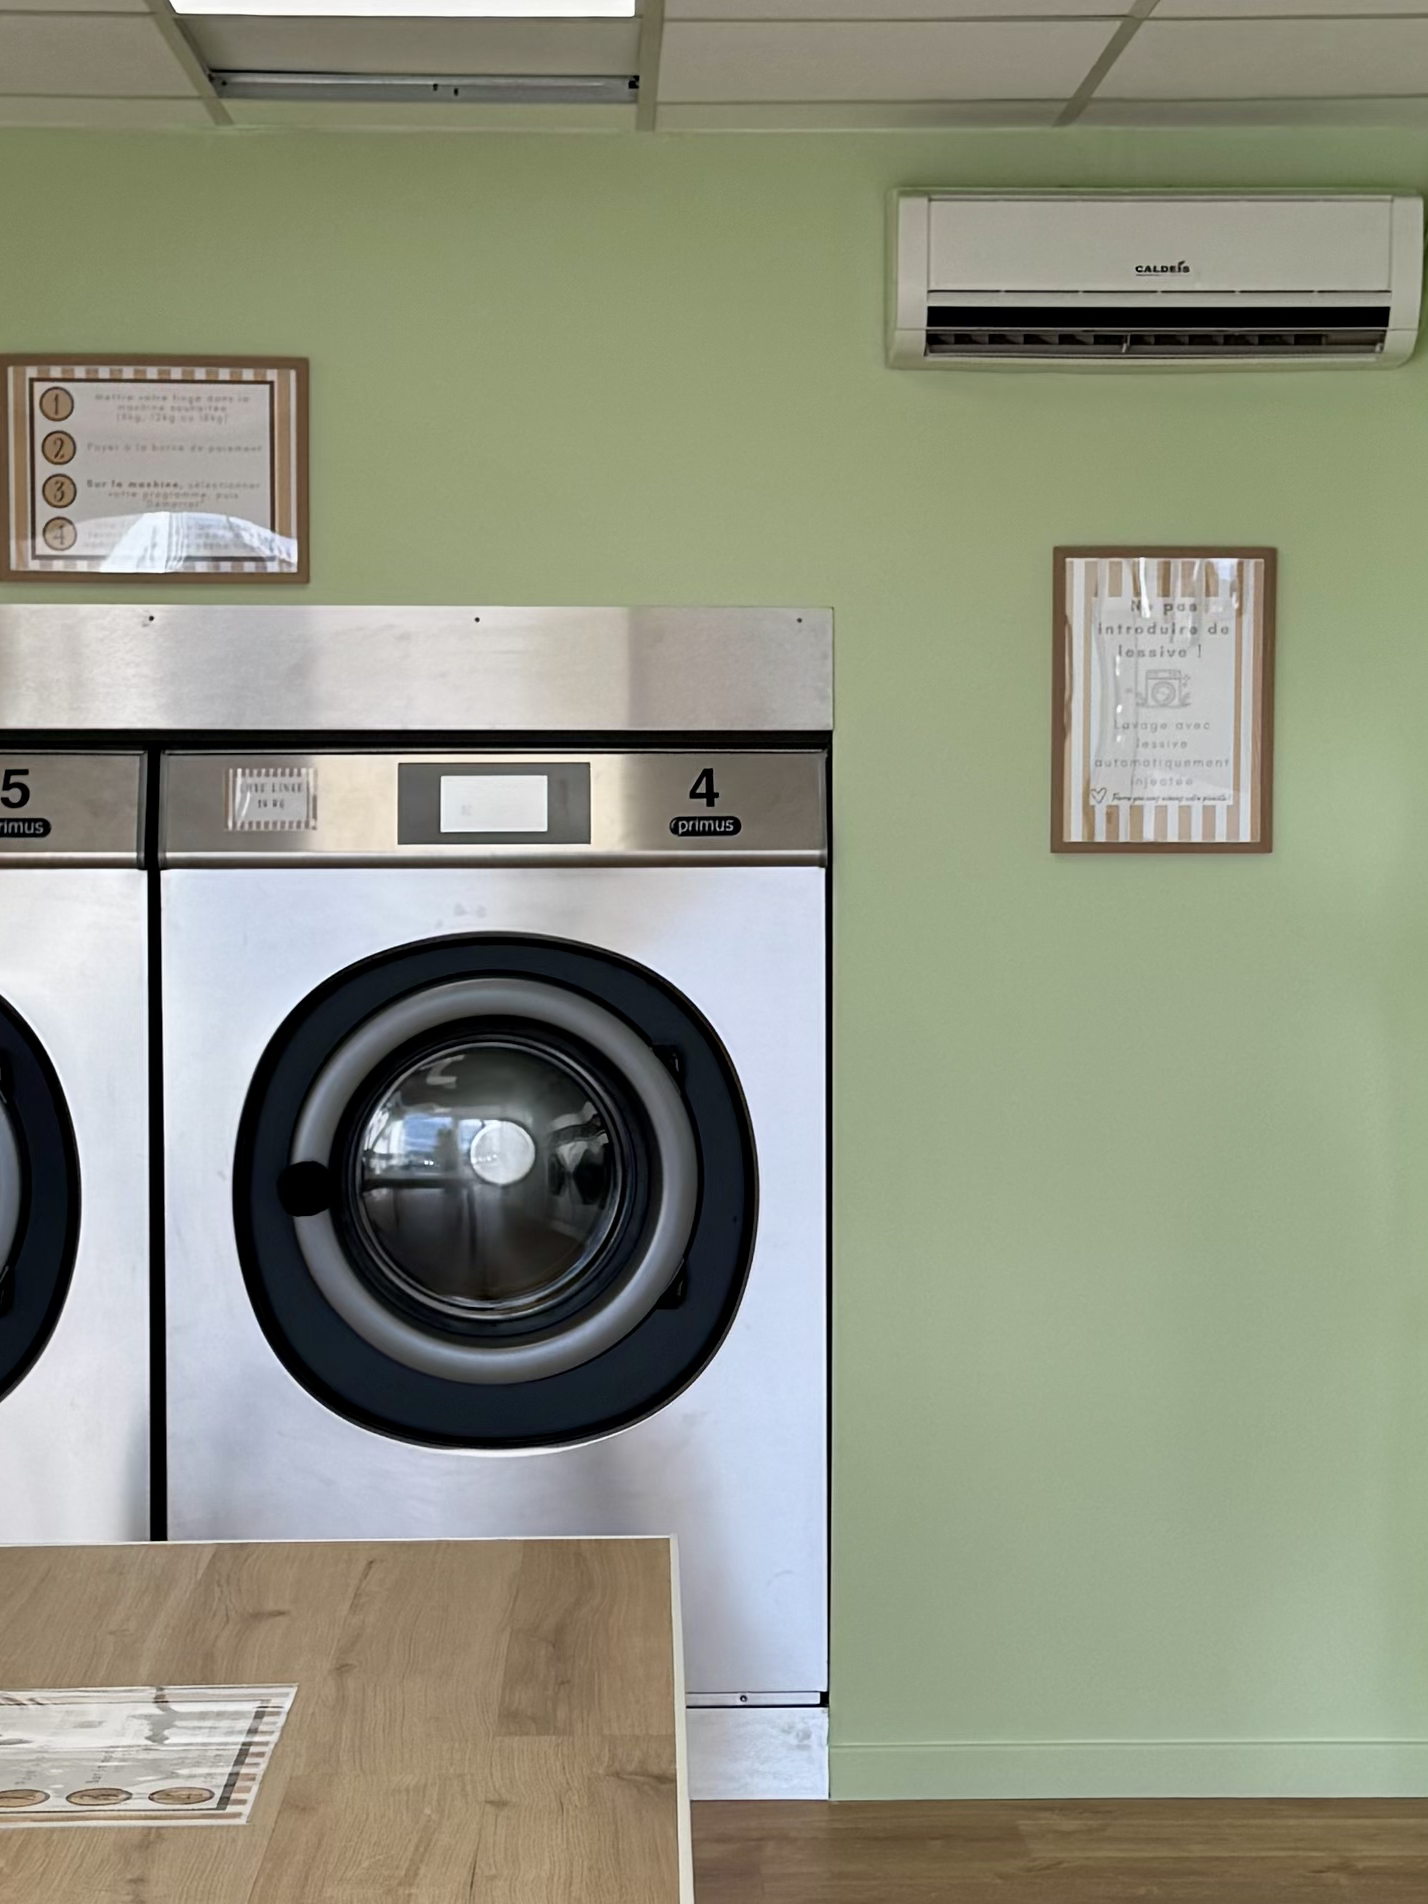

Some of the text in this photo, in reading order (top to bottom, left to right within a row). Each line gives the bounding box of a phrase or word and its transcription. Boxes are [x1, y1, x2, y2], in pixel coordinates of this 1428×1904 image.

[52, 393, 60, 416] 1
[53, 437, 66, 460] 2
[53, 480, 65, 502] 3
[52, 524, 66, 545] 4
[1163, 603, 1198, 616] pas
[1098, 622, 1230, 635] introduire de
[1118, 644, 1188, 658] lessive
[1114, 719, 1211, 734] Lavage avec
[1136, 737, 1188, 749] lessive
[1094, 758, 1230, 770] automatiquement
[0, 768, 30, 809] 5
[689, 767, 719, 807] 4
[678, 817, 734, 835] primus
